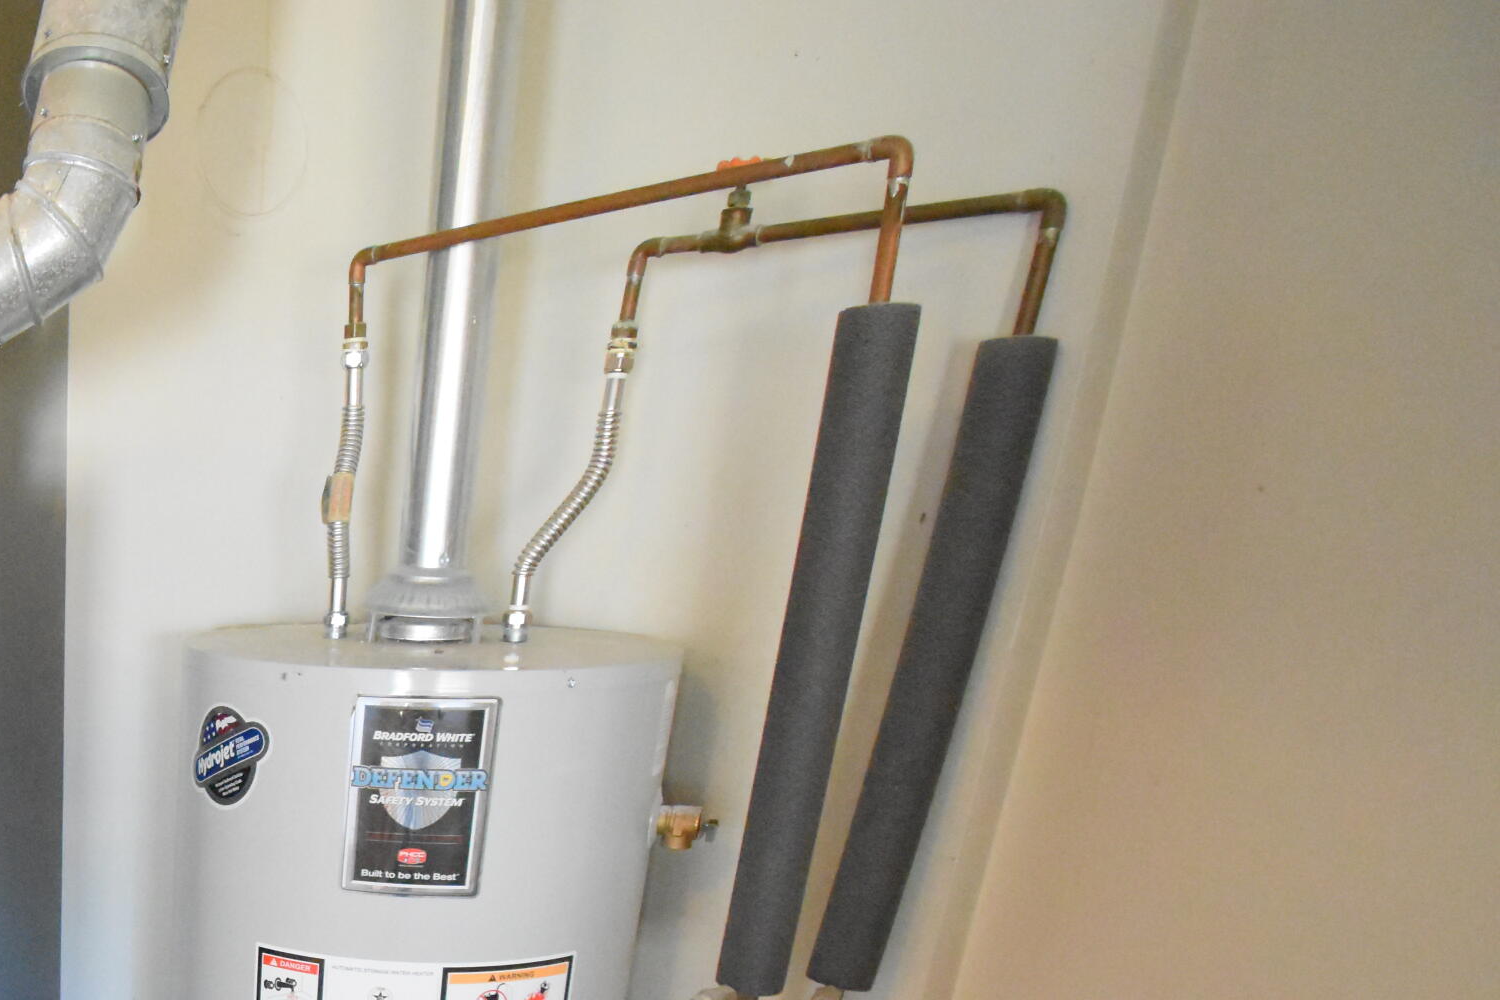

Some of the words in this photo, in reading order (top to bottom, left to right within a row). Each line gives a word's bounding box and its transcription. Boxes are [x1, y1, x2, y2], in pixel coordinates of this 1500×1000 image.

[372, 730, 434, 743] BRADFORD
[435, 732, 474, 743] WHITE
[352, 766, 488, 791] DEFENDER
[368, 794, 413, 805] SAFETY
[414, 796, 464, 807] SYSTEM
[360, 868, 383, 878] Built
[385, 870, 396, 879] to
[397, 871, 412, 880] be
[414, 872, 431, 880] the
[432, 872, 457, 881] Best
[280, 959, 311, 972] DANGER
[499, 971, 535, 981] WARNING
